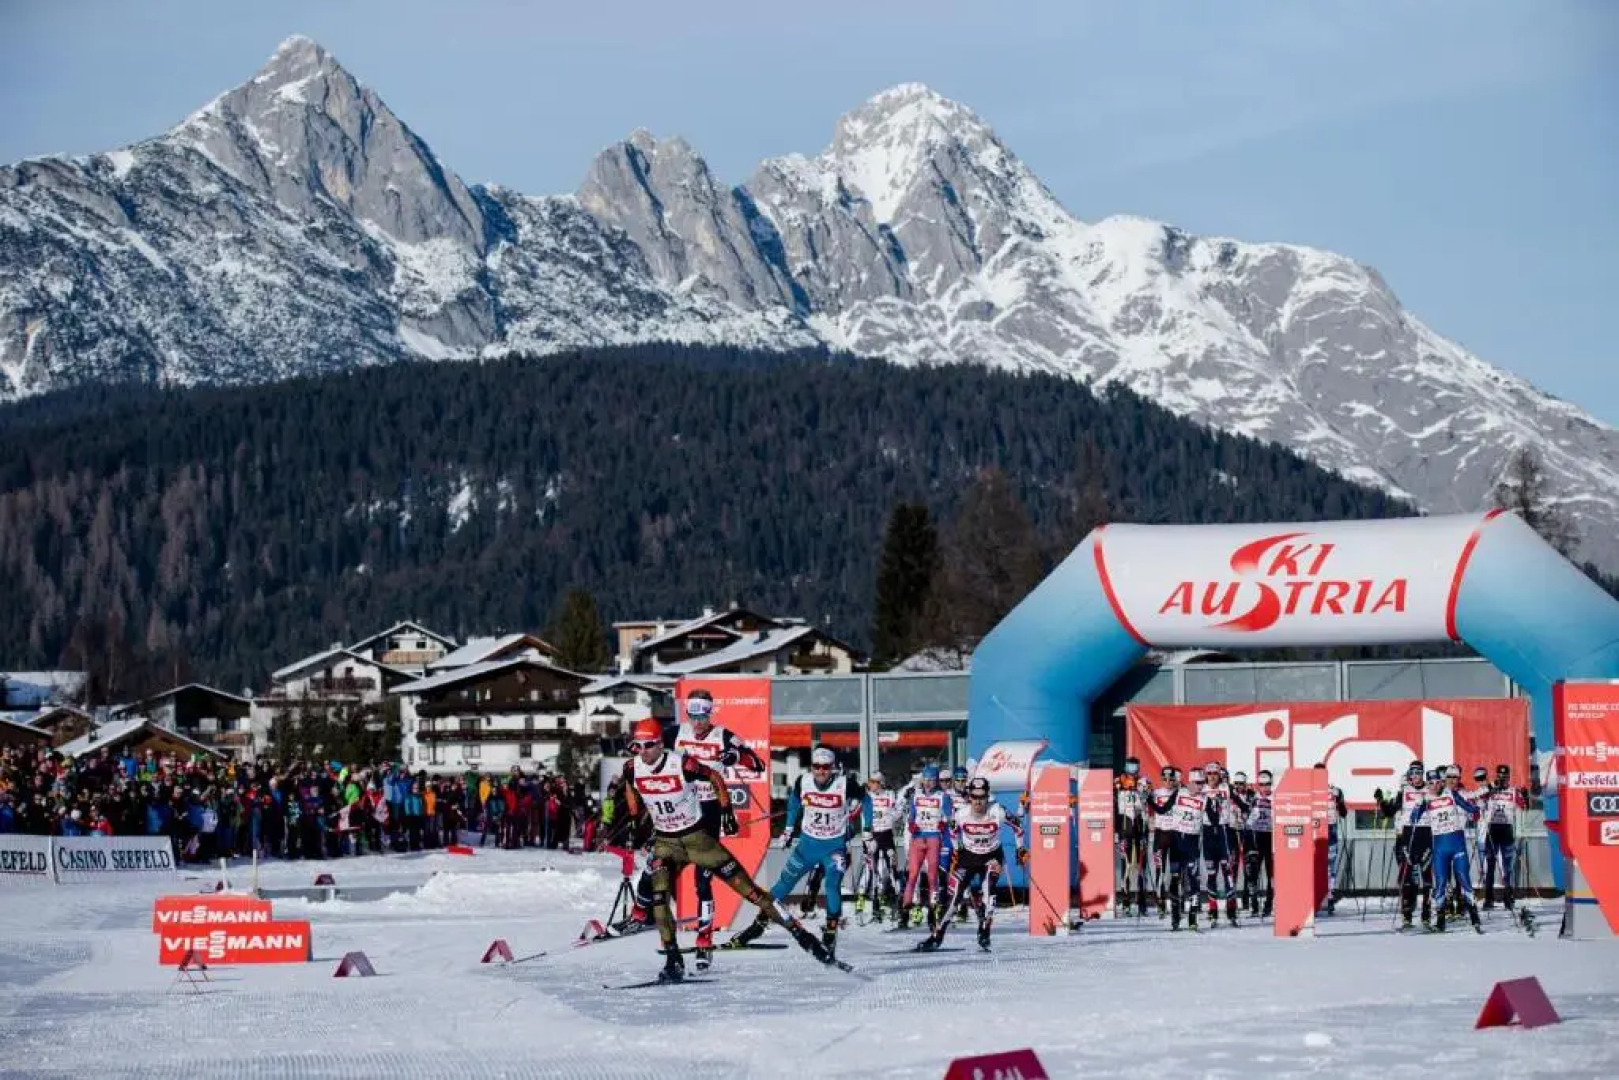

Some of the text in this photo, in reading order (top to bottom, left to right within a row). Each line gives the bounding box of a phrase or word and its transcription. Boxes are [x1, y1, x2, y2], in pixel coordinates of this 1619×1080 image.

[1159, 579, 1407, 632] AUSTRIA
[655, 800, 675, 815] 18
[814, 812, 830, 825] 21
[0, 850, 47, 872] EFELD
[59, 847, 170, 869] CASINO SEEFELD
[157, 905, 268, 924] VIESSMANN
[164, 930, 303, 959] VIESSMANN
